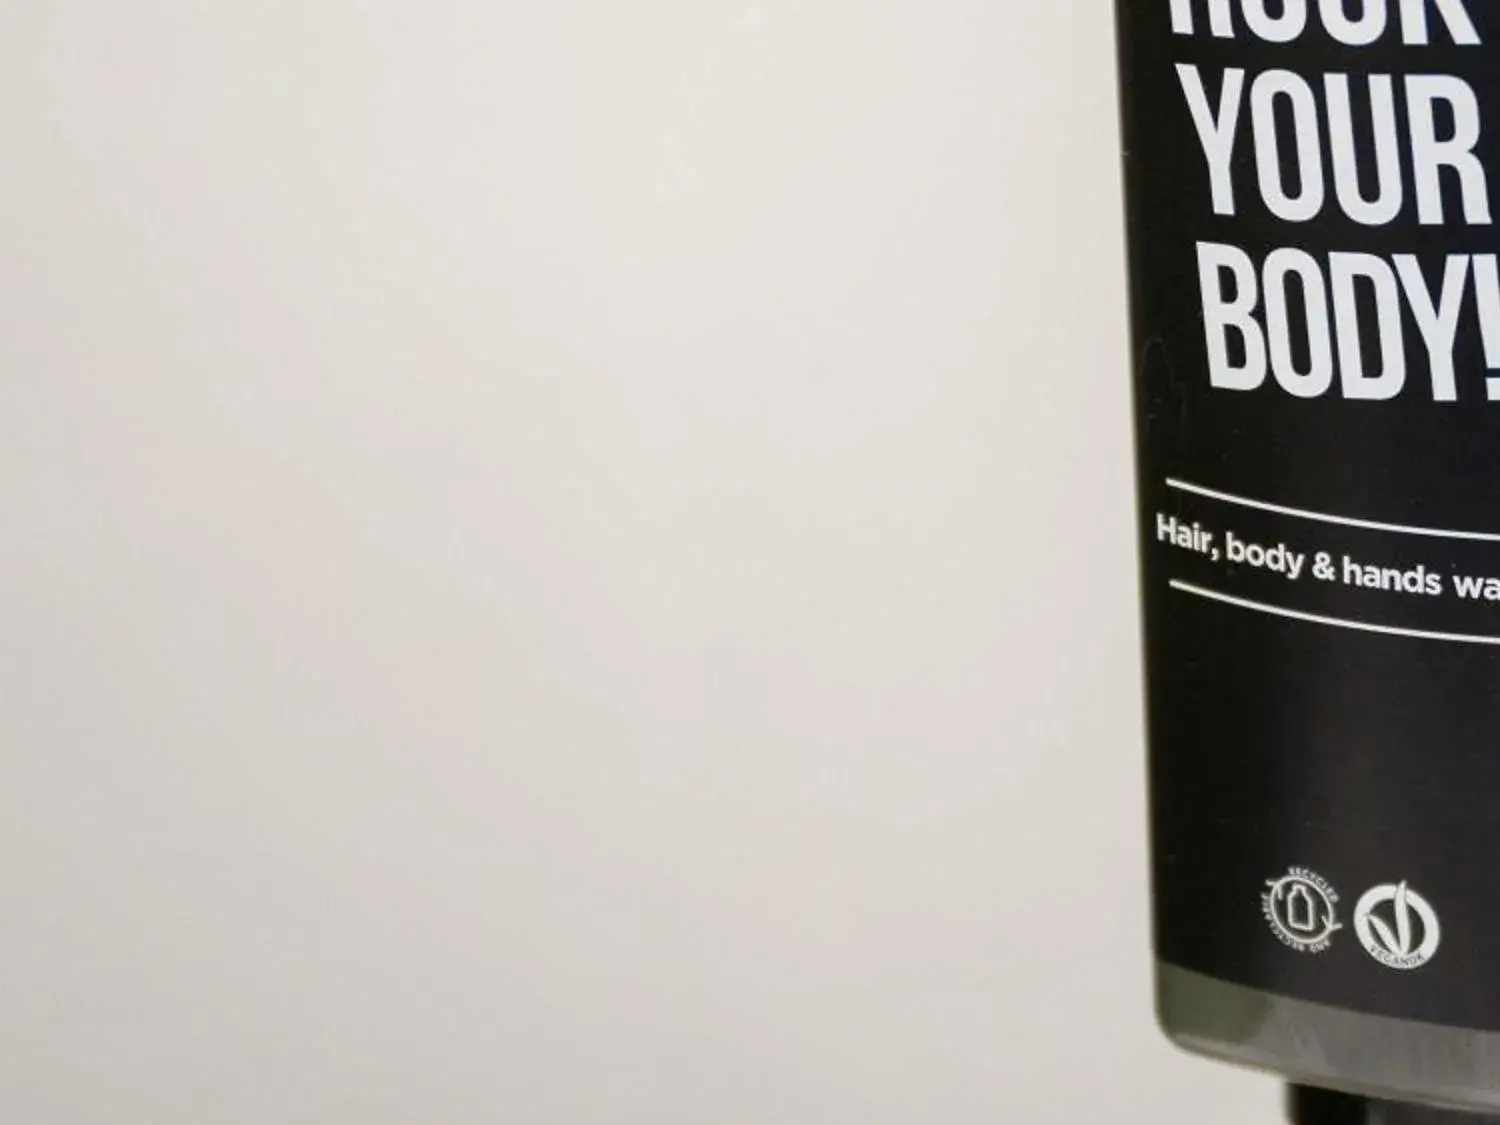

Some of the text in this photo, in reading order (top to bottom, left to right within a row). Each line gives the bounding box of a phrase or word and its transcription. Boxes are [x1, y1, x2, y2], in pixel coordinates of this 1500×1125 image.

[1174, 62, 1493, 226] YOUR
[1156, 512, 1220, 561] Hair,
[1225, 532, 1304, 580] body
[1312, 551, 1336, 581] &
[1343, 556, 1442, 596] hands
